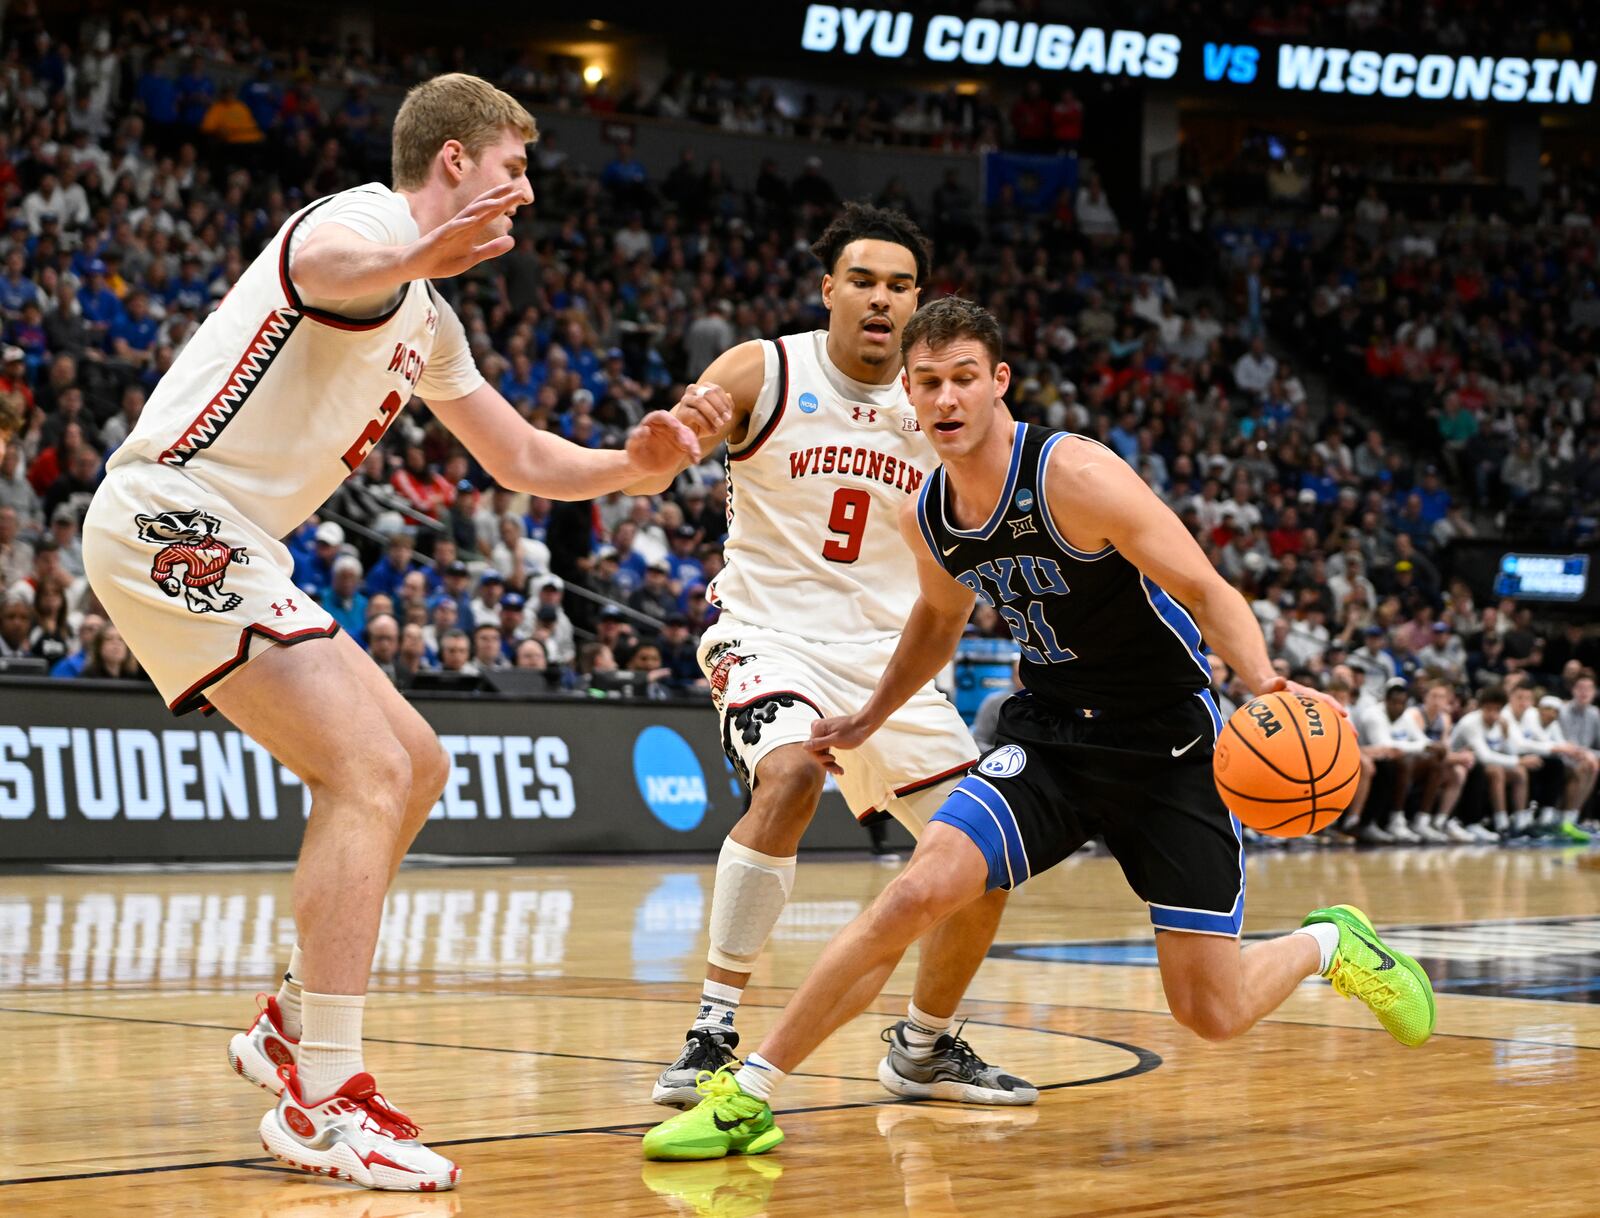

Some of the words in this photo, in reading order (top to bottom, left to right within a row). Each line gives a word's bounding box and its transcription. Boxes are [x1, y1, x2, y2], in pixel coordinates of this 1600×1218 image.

[801, 4, 914, 57] BYU
[924, 14, 1182, 79] COUGARS
[1203, 42, 1260, 83] VS
[1277, 43, 1597, 104] WISCONSIN
[789, 446, 923, 494] WISCONSIN
[822, 487, 871, 564] 9
[1000, 601, 1079, 665] 21
[645, 775, 708, 805] NCAA
